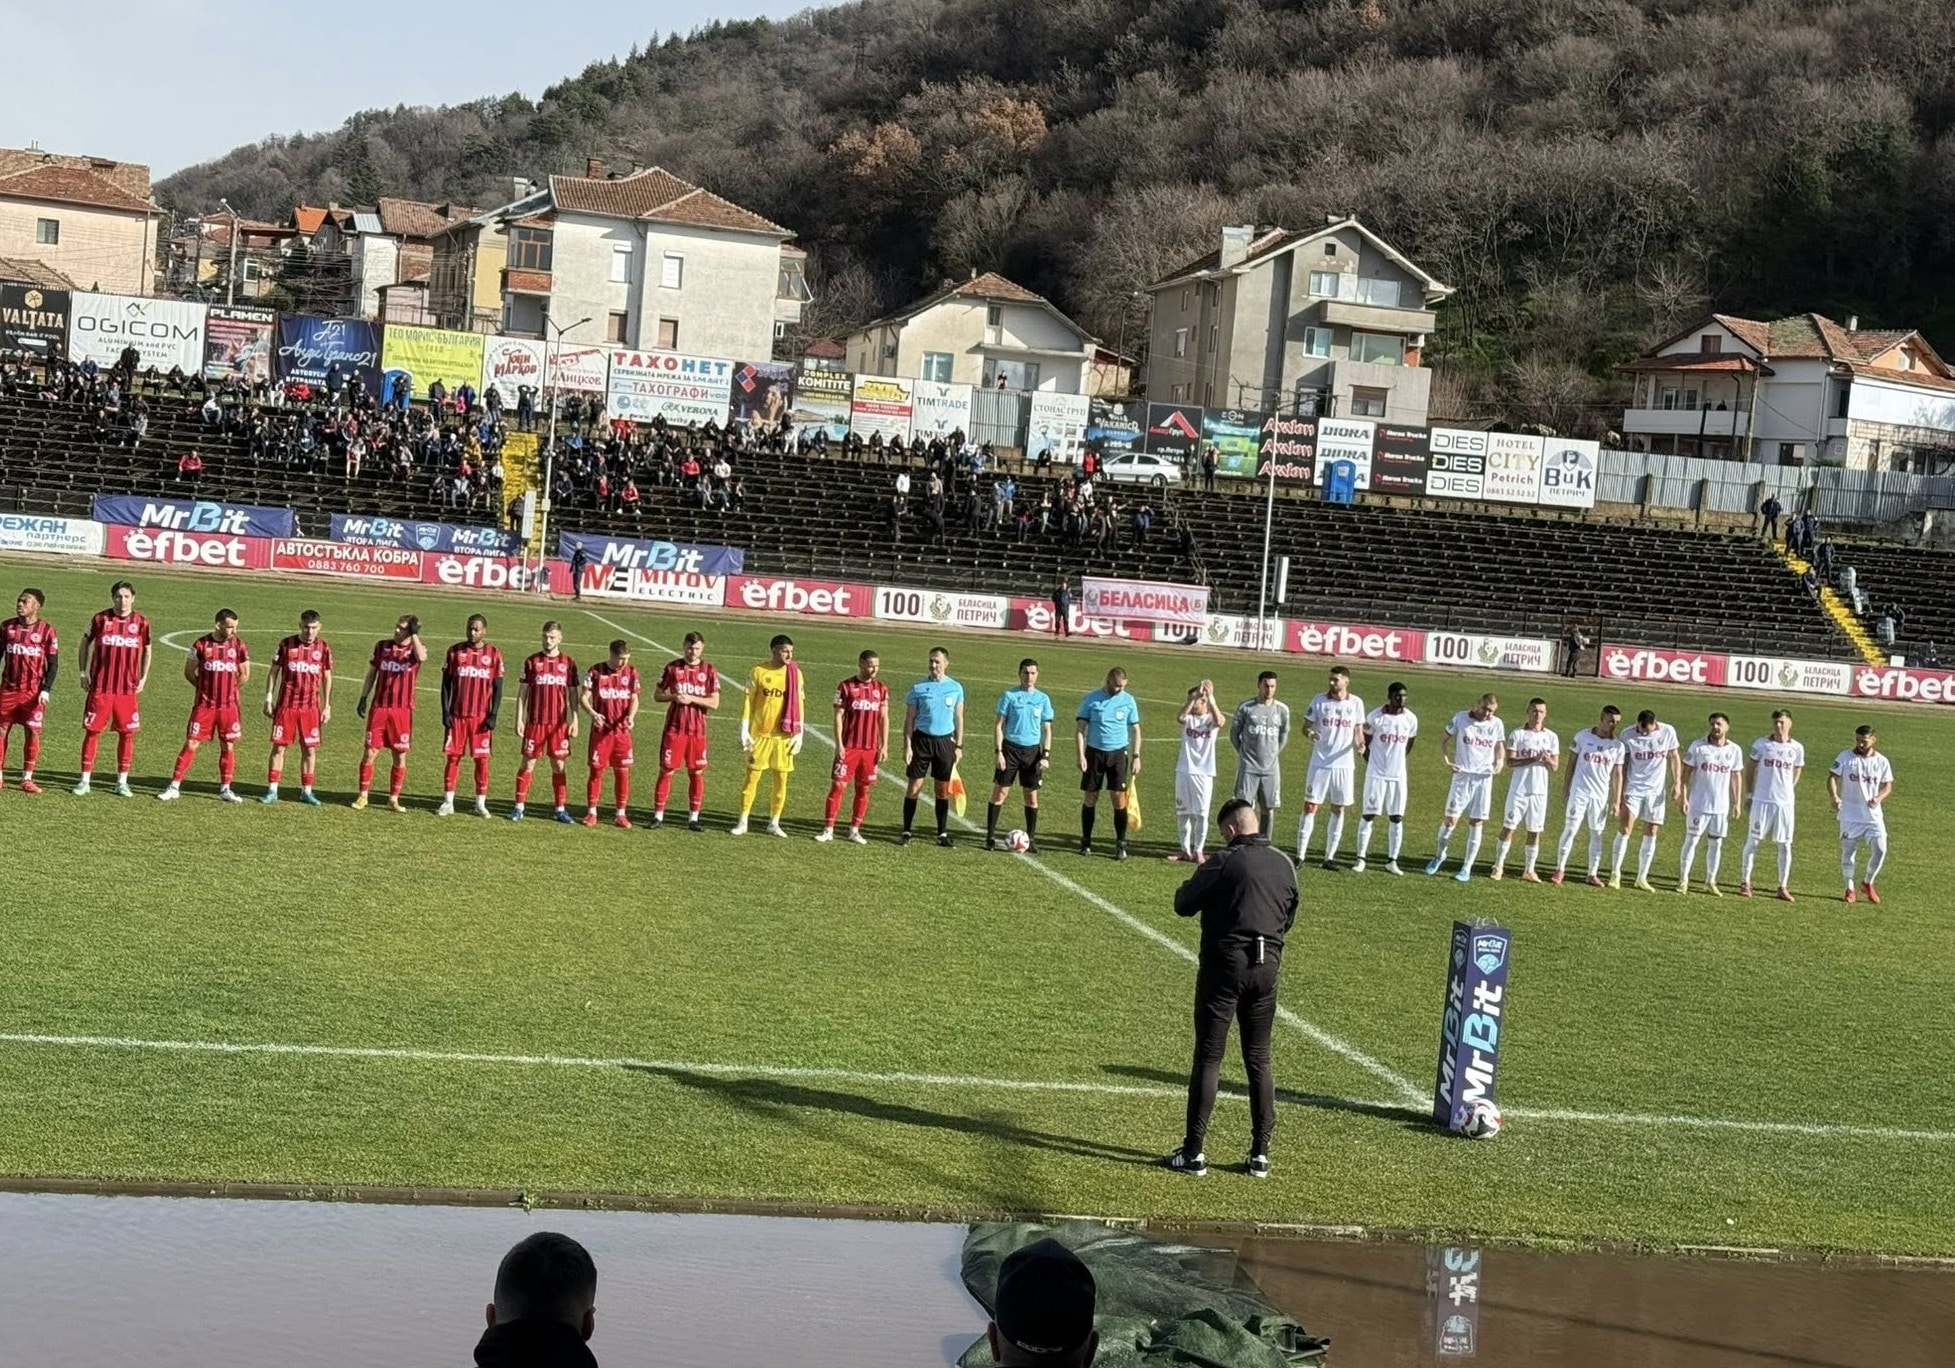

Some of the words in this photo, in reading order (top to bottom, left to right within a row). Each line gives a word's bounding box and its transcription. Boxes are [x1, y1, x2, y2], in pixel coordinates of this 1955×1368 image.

[2, 308, 64, 330] VALTATA
[210, 308, 273, 322] PLAMEN
[78, 316, 198, 341] OGICOM
[614, 352, 727, 376] ТАХОНЕТ
[290, 368, 328, 378] АВТОБУСН
[803, 370, 847, 380] COMPLEX
[632, 382, 709, 399] ТАХОГРАФИ
[798, 376, 852, 390] KOMITITE
[682, 405, 718, 416] VERONA
[917, 396, 968, 410] TIMTRADE
[1435, 433, 1484, 451] DIES
[1496, 438, 1536, 450] HOTEL
[1432, 454, 1483, 473] DIES
[1488, 452, 1540, 471] CITY
[1431, 476, 1480, 493] DIES
[1491, 472, 1534, 485] Petrich
[139, 501, 250, 535] MrBit
[343, 517, 404, 539] MrBit
[26, 532, 87, 543] партнерс
[374, 538, 399, 548] ЛИГА
[452, 527, 512, 548] MrBit
[125, 530, 247, 567] efbet
[276, 541, 370, 562] АВТОСТЪКЛА
[373, 549, 419, 565] КОБРА
[454, 546, 482, 555] ВТОРА
[482, 549, 506, 558] ЛИГА
[601, 541, 704, 573] MrBit
[307, 559, 337, 571] 0883
[340, 562, 361, 572] 760
[364, 564, 385, 574] 700
[640, 570, 719, 589] MITOV
[638, 587, 714, 601] ELECTRIC
[742, 581, 851, 614] efbet
[1099, 590, 1189, 614] БЕЛАСИЦА
[883, 591, 920, 616] 100
[958, 598, 997, 610] БЕЛАСИЦА
[956, 609, 997, 623] ПЕТРИЧ
[1028, 604, 1131, 638] ebet
[102, 634, 139, 648] efbet
[1300, 626, 1402, 658] efbet
[1433, 635, 1469, 659] 100
[1504, 642, 1541, 654] БЕЛАСИЦА
[1503, 653, 1541, 666] ПЕТРИЧ
[1608, 651, 1708, 683] efbet
[1735, 660, 1769, 684] 100
[1804, 665, 1841, 676] БЕЛАСИЦА
[1803, 676, 1841, 689] ПЕТРИЧ
[1858, 670, 1955, 702] efbet
[762, 687, 787, 698] efb
[834, 763, 847, 776] 26
[1439, 974, 1465, 1106] MrBit
[1462, 980, 1503, 1101] MrBit
